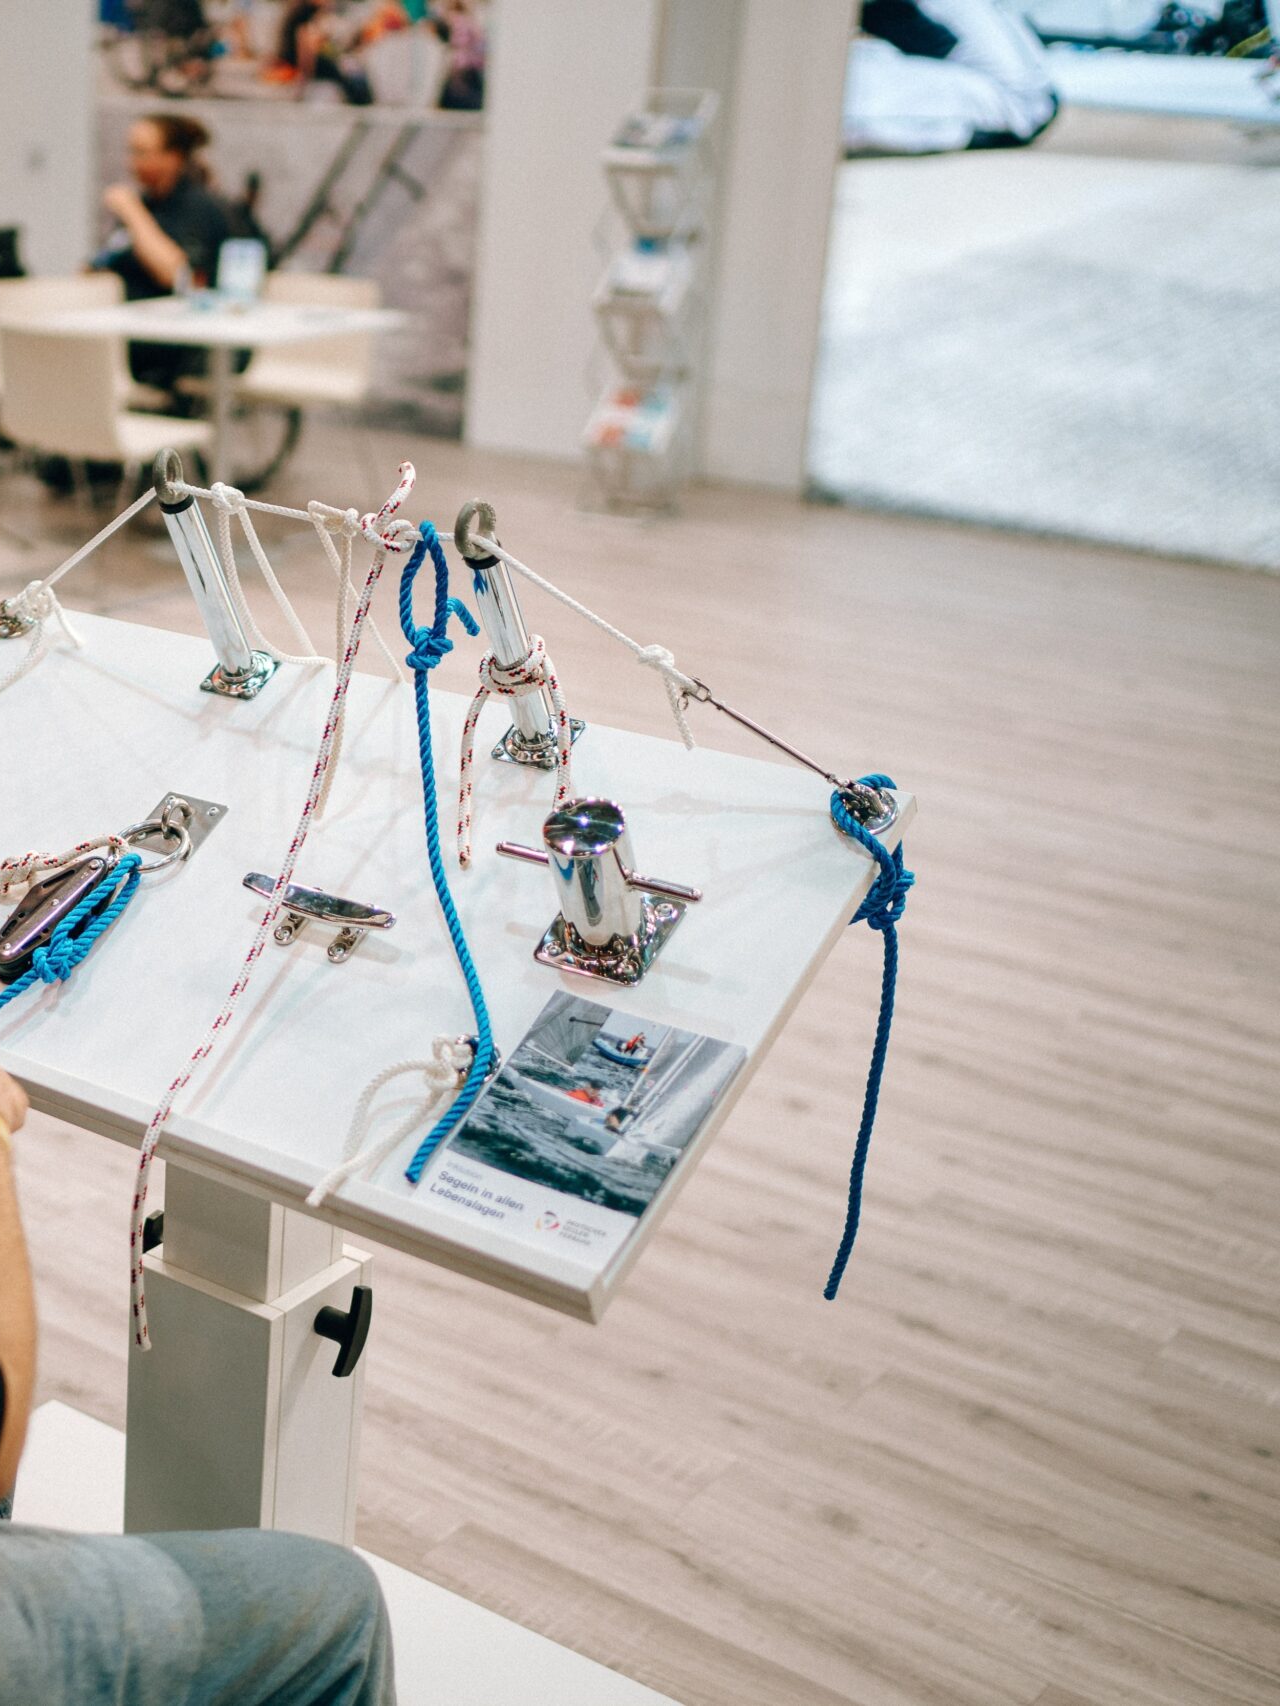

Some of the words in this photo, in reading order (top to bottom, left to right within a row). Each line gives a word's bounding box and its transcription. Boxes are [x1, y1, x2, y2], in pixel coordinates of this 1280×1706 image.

[429, 1182, 506, 1220] Lebenslagen
[439, 1170, 480, 1194] Segeln
[481, 1187, 494, 1200] in
[495, 1194, 525, 1211] allen
